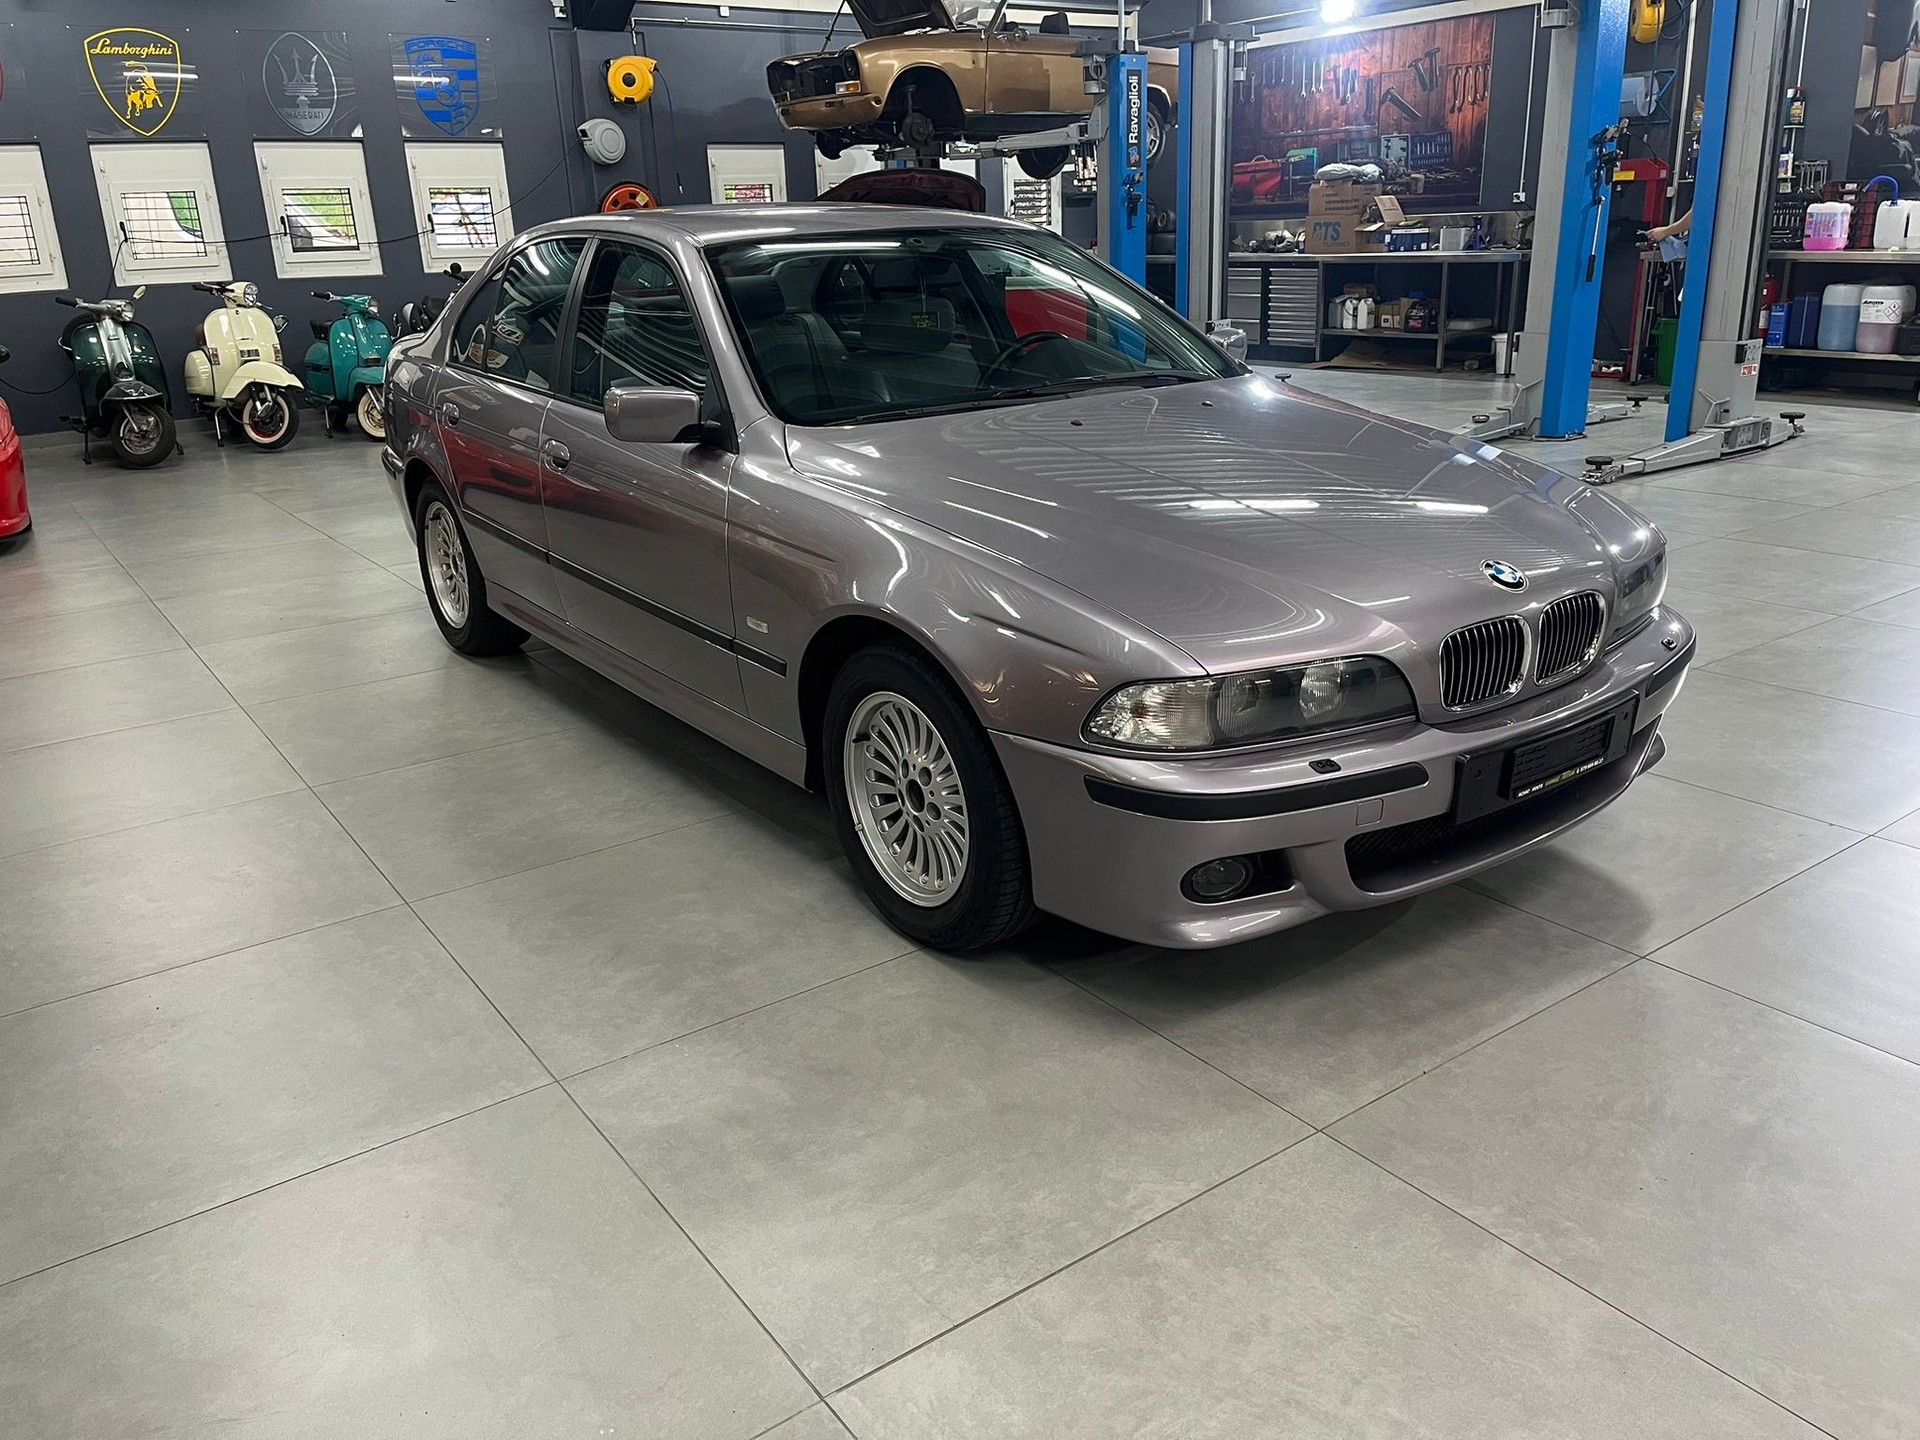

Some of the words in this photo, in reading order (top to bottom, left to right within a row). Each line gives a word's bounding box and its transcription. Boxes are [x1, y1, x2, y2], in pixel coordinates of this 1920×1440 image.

[89, 37, 173, 59] Lamborghini
[406, 40, 474, 53] PORSCHE
[1129, 76, 1140, 144] Ravaglioli
